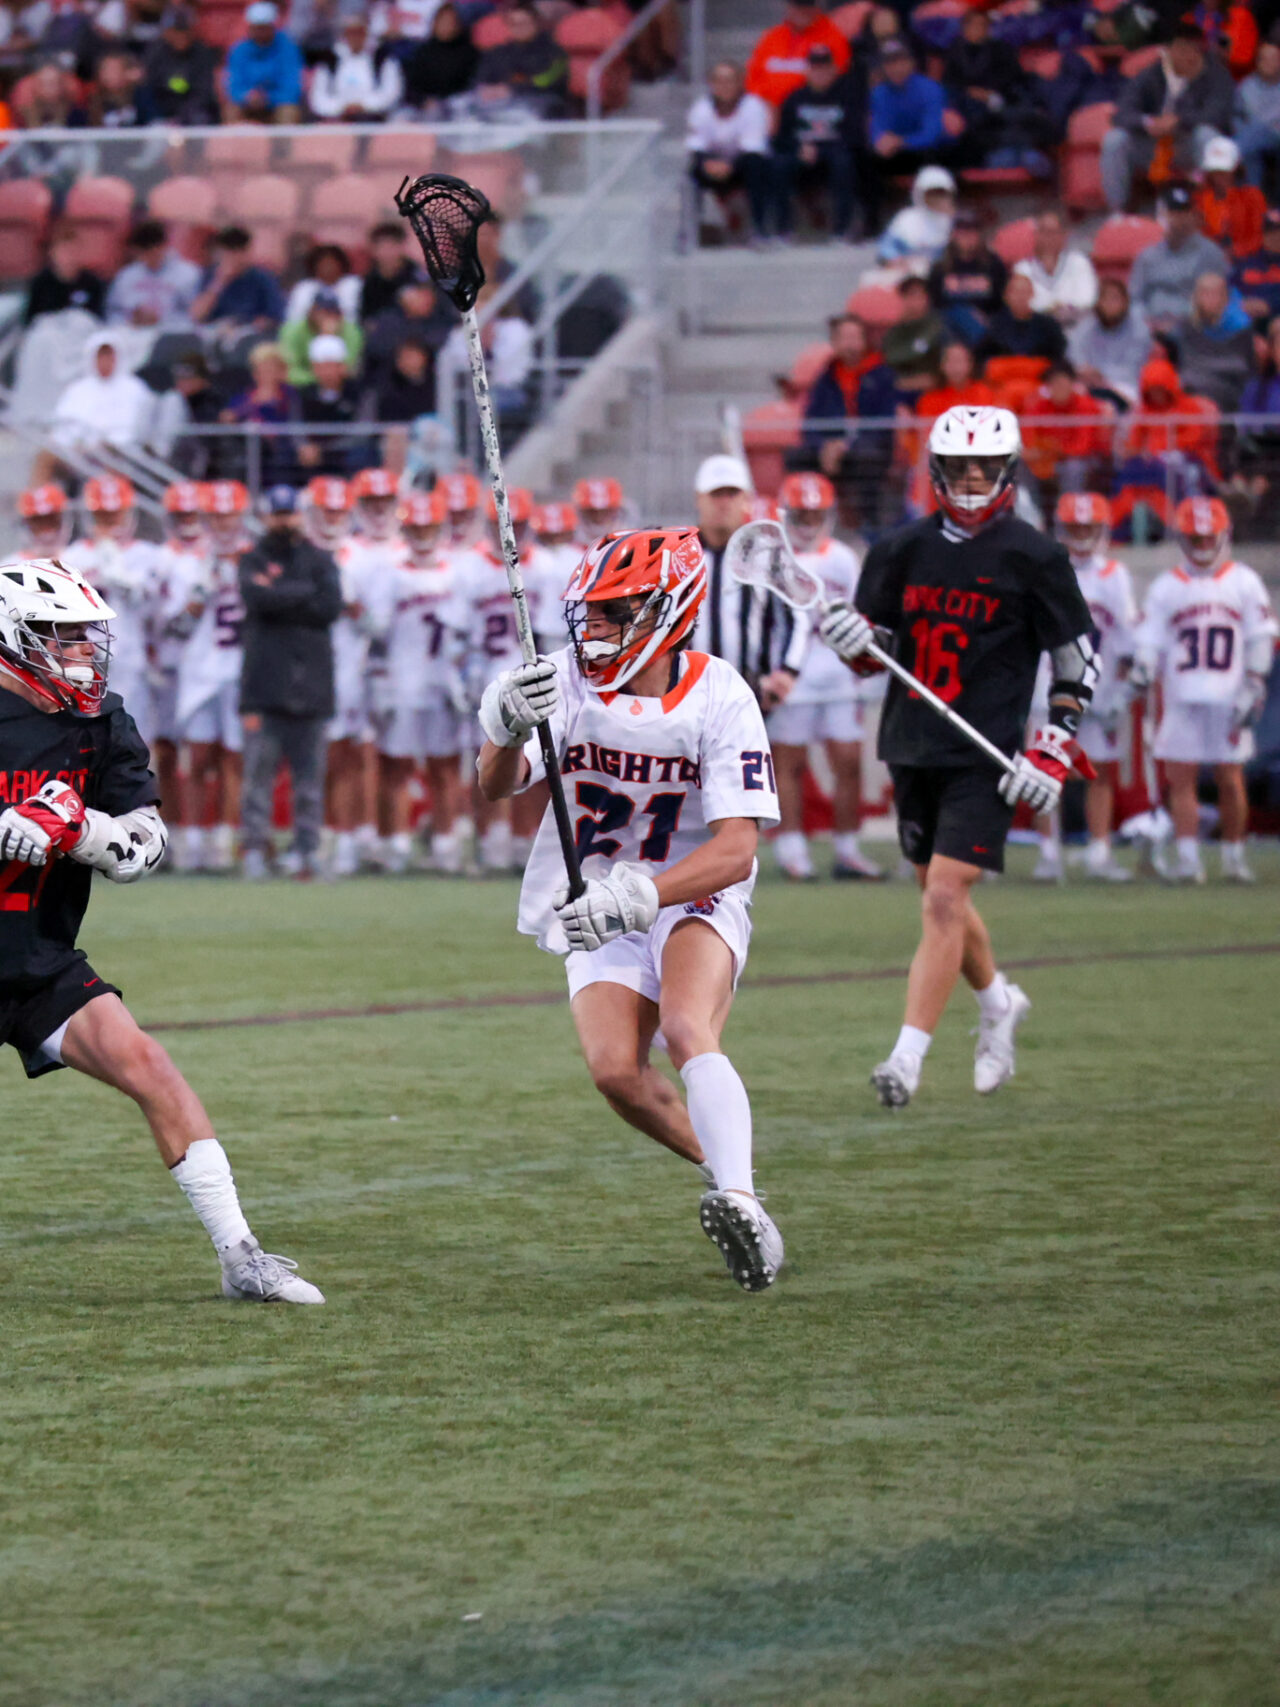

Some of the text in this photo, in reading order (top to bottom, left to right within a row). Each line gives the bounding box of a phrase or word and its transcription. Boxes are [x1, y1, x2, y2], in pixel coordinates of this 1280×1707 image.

[907, 618, 969, 703] 16
[1178, 626, 1235, 671] 30
[561, 742, 703, 789] RIGHTO
[740, 751, 777, 793] 21
[576, 781, 687, 862] 21
